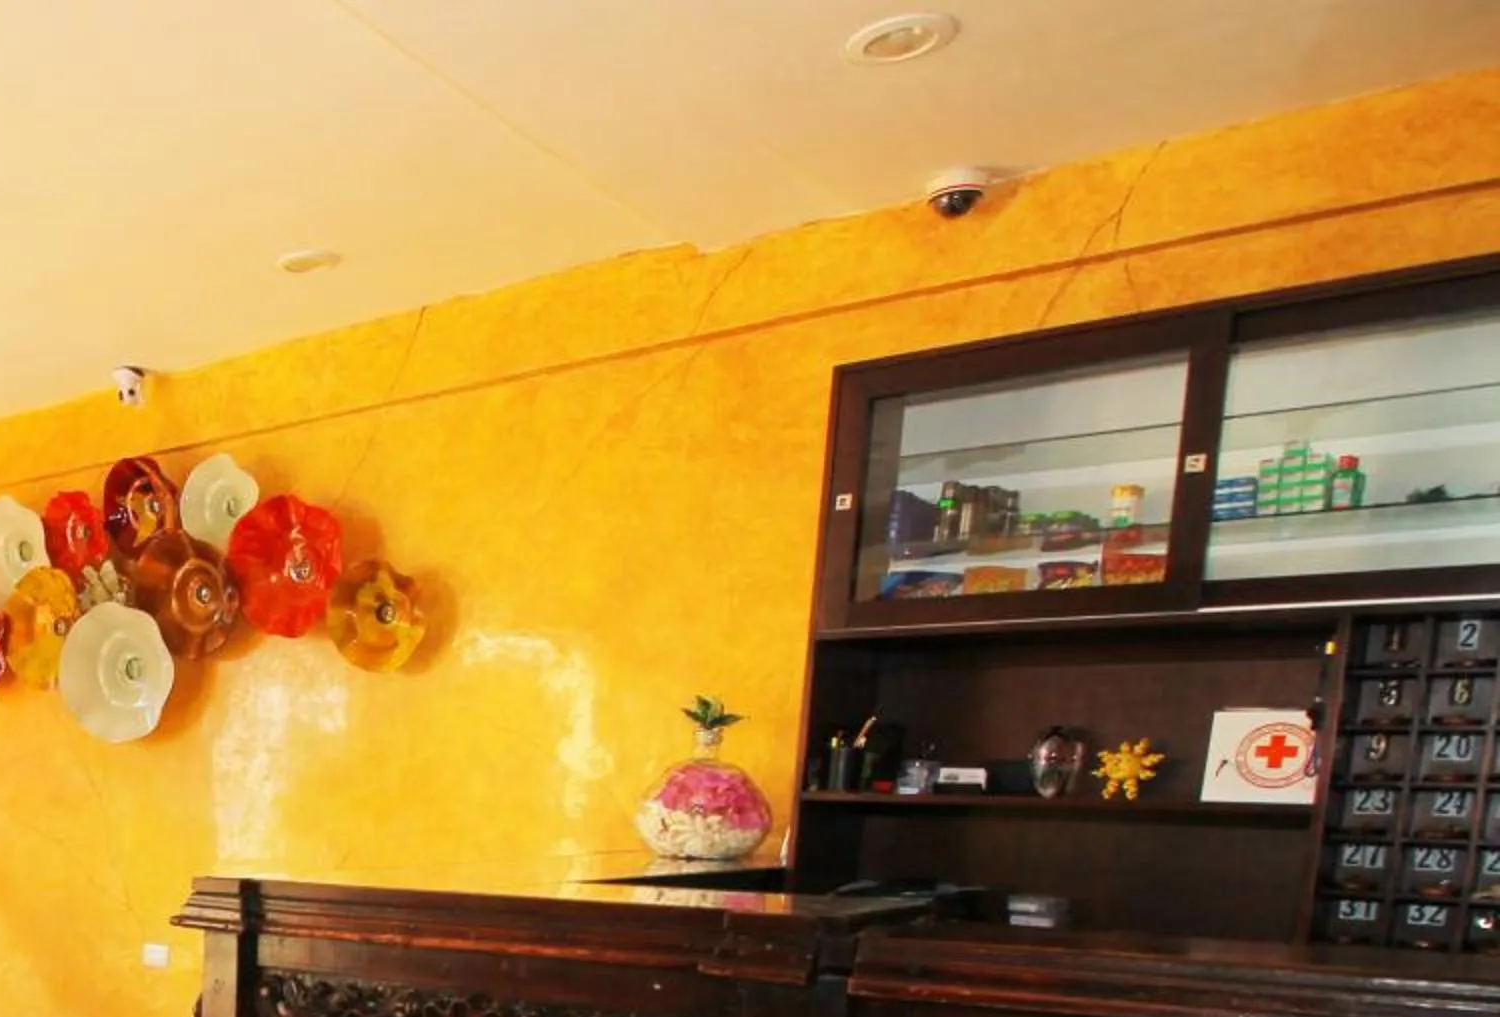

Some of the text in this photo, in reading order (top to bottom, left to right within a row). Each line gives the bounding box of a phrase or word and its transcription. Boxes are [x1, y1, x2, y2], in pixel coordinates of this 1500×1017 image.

[1460, 622, 1477, 648] 2
[1453, 678, 1470, 704] 6
[1367, 733, 1387, 762] 9
[1436, 735, 1471, 758] 20
[1357, 789, 1389, 812] 23
[1436, 790, 1467, 815] 24
[1345, 845, 1381, 867] 27
[1418, 847, 1450, 870] 28
[1410, 906, 1443, 923] 32
